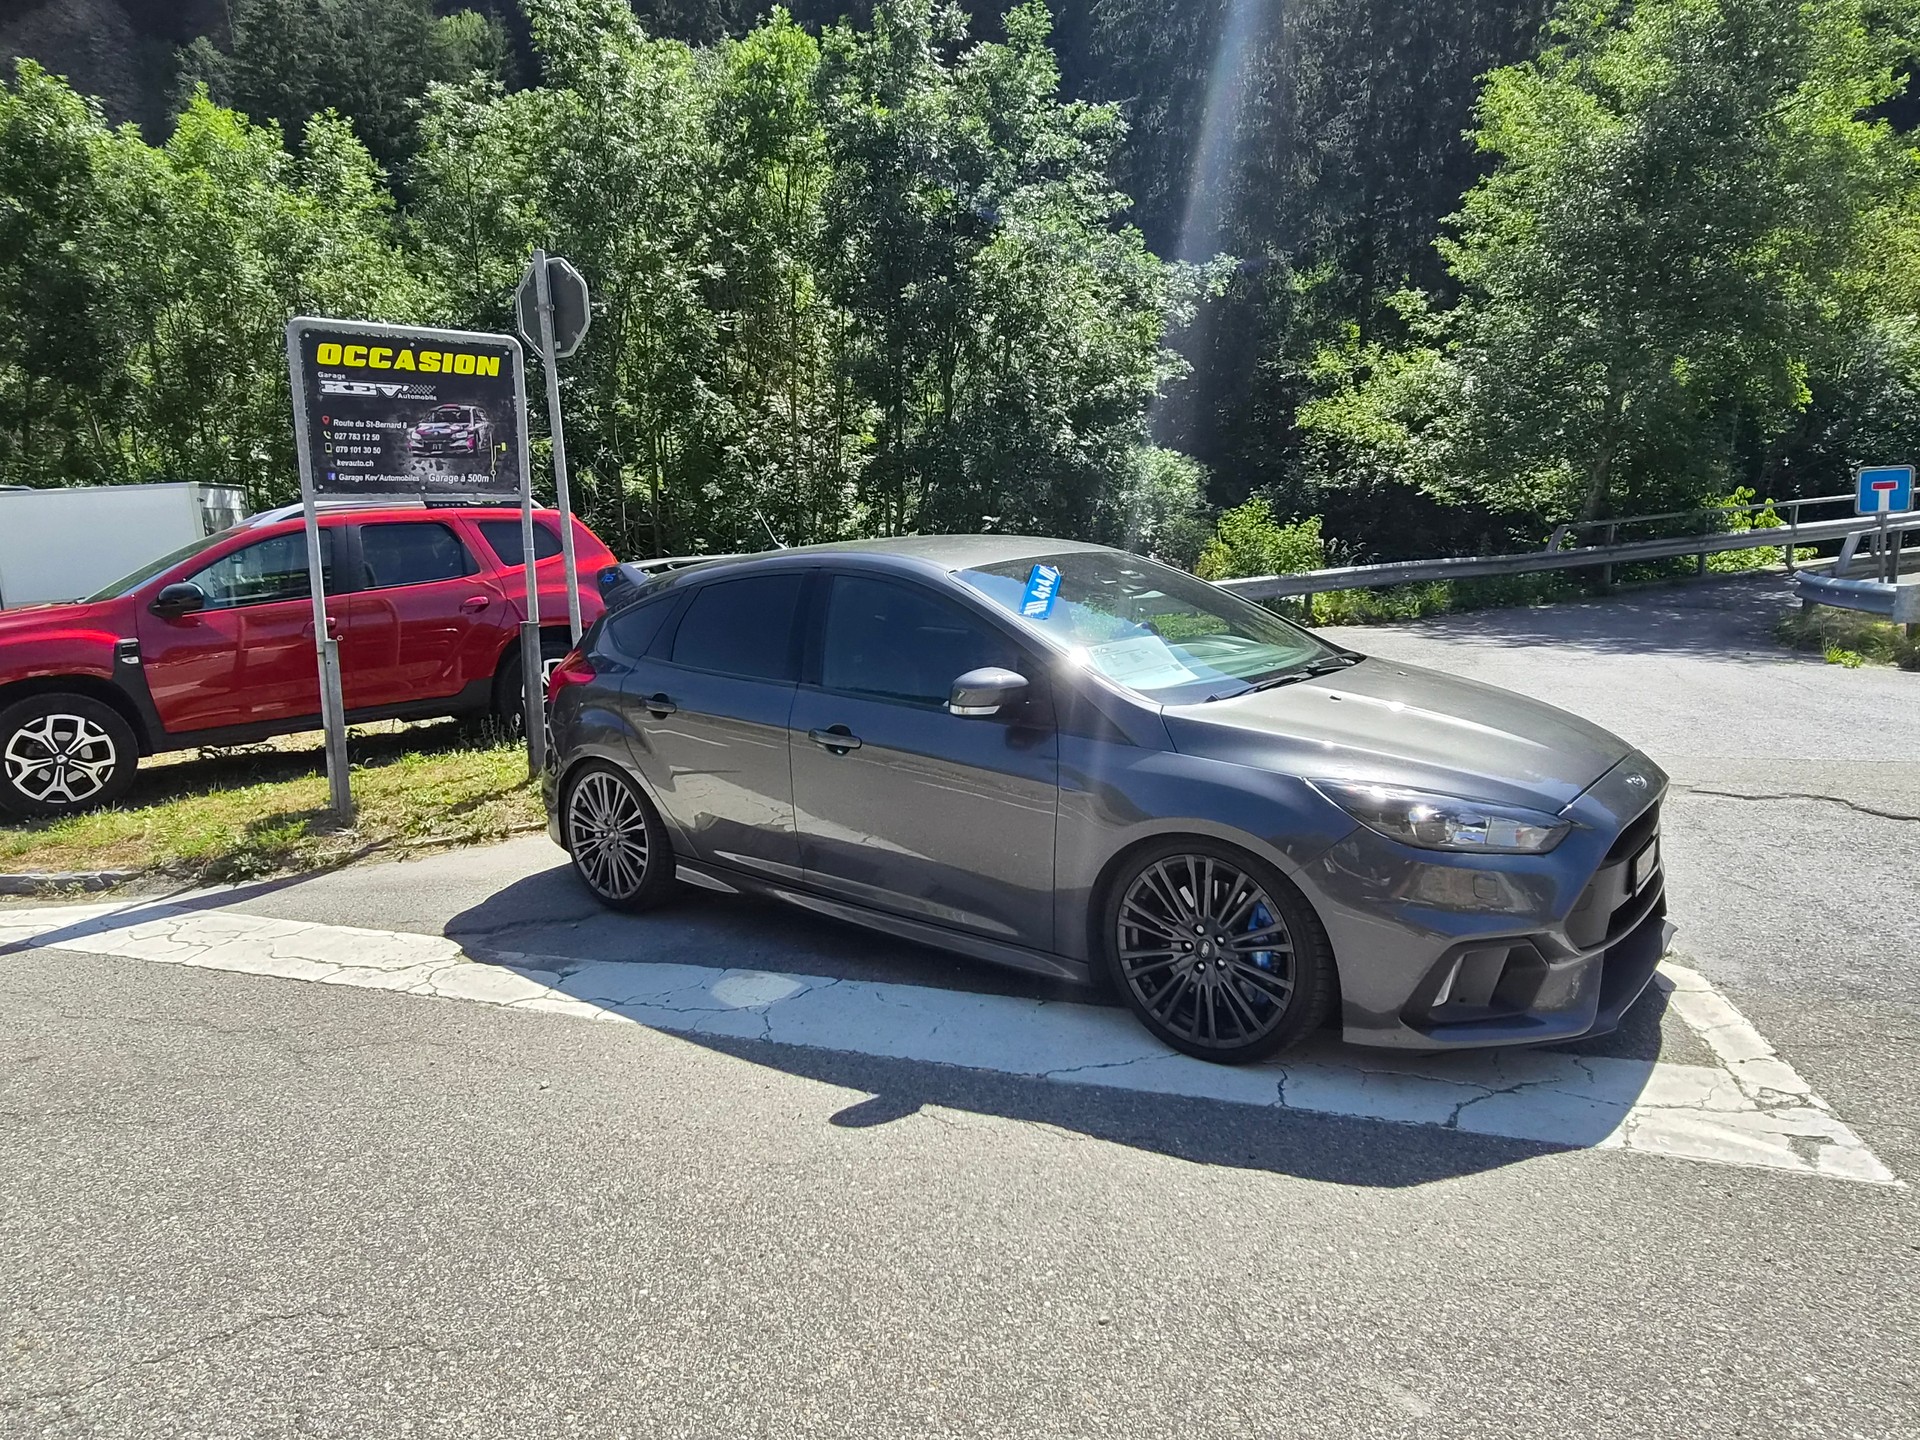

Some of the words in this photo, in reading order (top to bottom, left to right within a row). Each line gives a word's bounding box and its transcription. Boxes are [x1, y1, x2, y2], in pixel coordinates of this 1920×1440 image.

[317, 343, 500, 376] OCCASION
[317, 371, 346, 380] Garage
[333, 419, 354, 427] Route
[355, 420, 364, 428] du
[365, 420, 402, 429] St-Bernard
[402, 421, 408, 429] 8
[334, 432, 347, 440] 027
[348, 433, 360, 441] 783
[362, 433, 370, 441] 12
[371, 433, 381, 441] 50
[350, 446, 361, 454] 101
[363, 446, 371, 454] 30
[372, 446, 381, 454] 50
[336, 459, 374, 467] kevauto.ch
[338, 473, 363, 483] Garage
[364, 473, 420, 482] Kev'Automobiles
[428, 473, 459, 485] Garage
[460, 473, 466, 483] à
[467, 473, 490, 483] 500m
